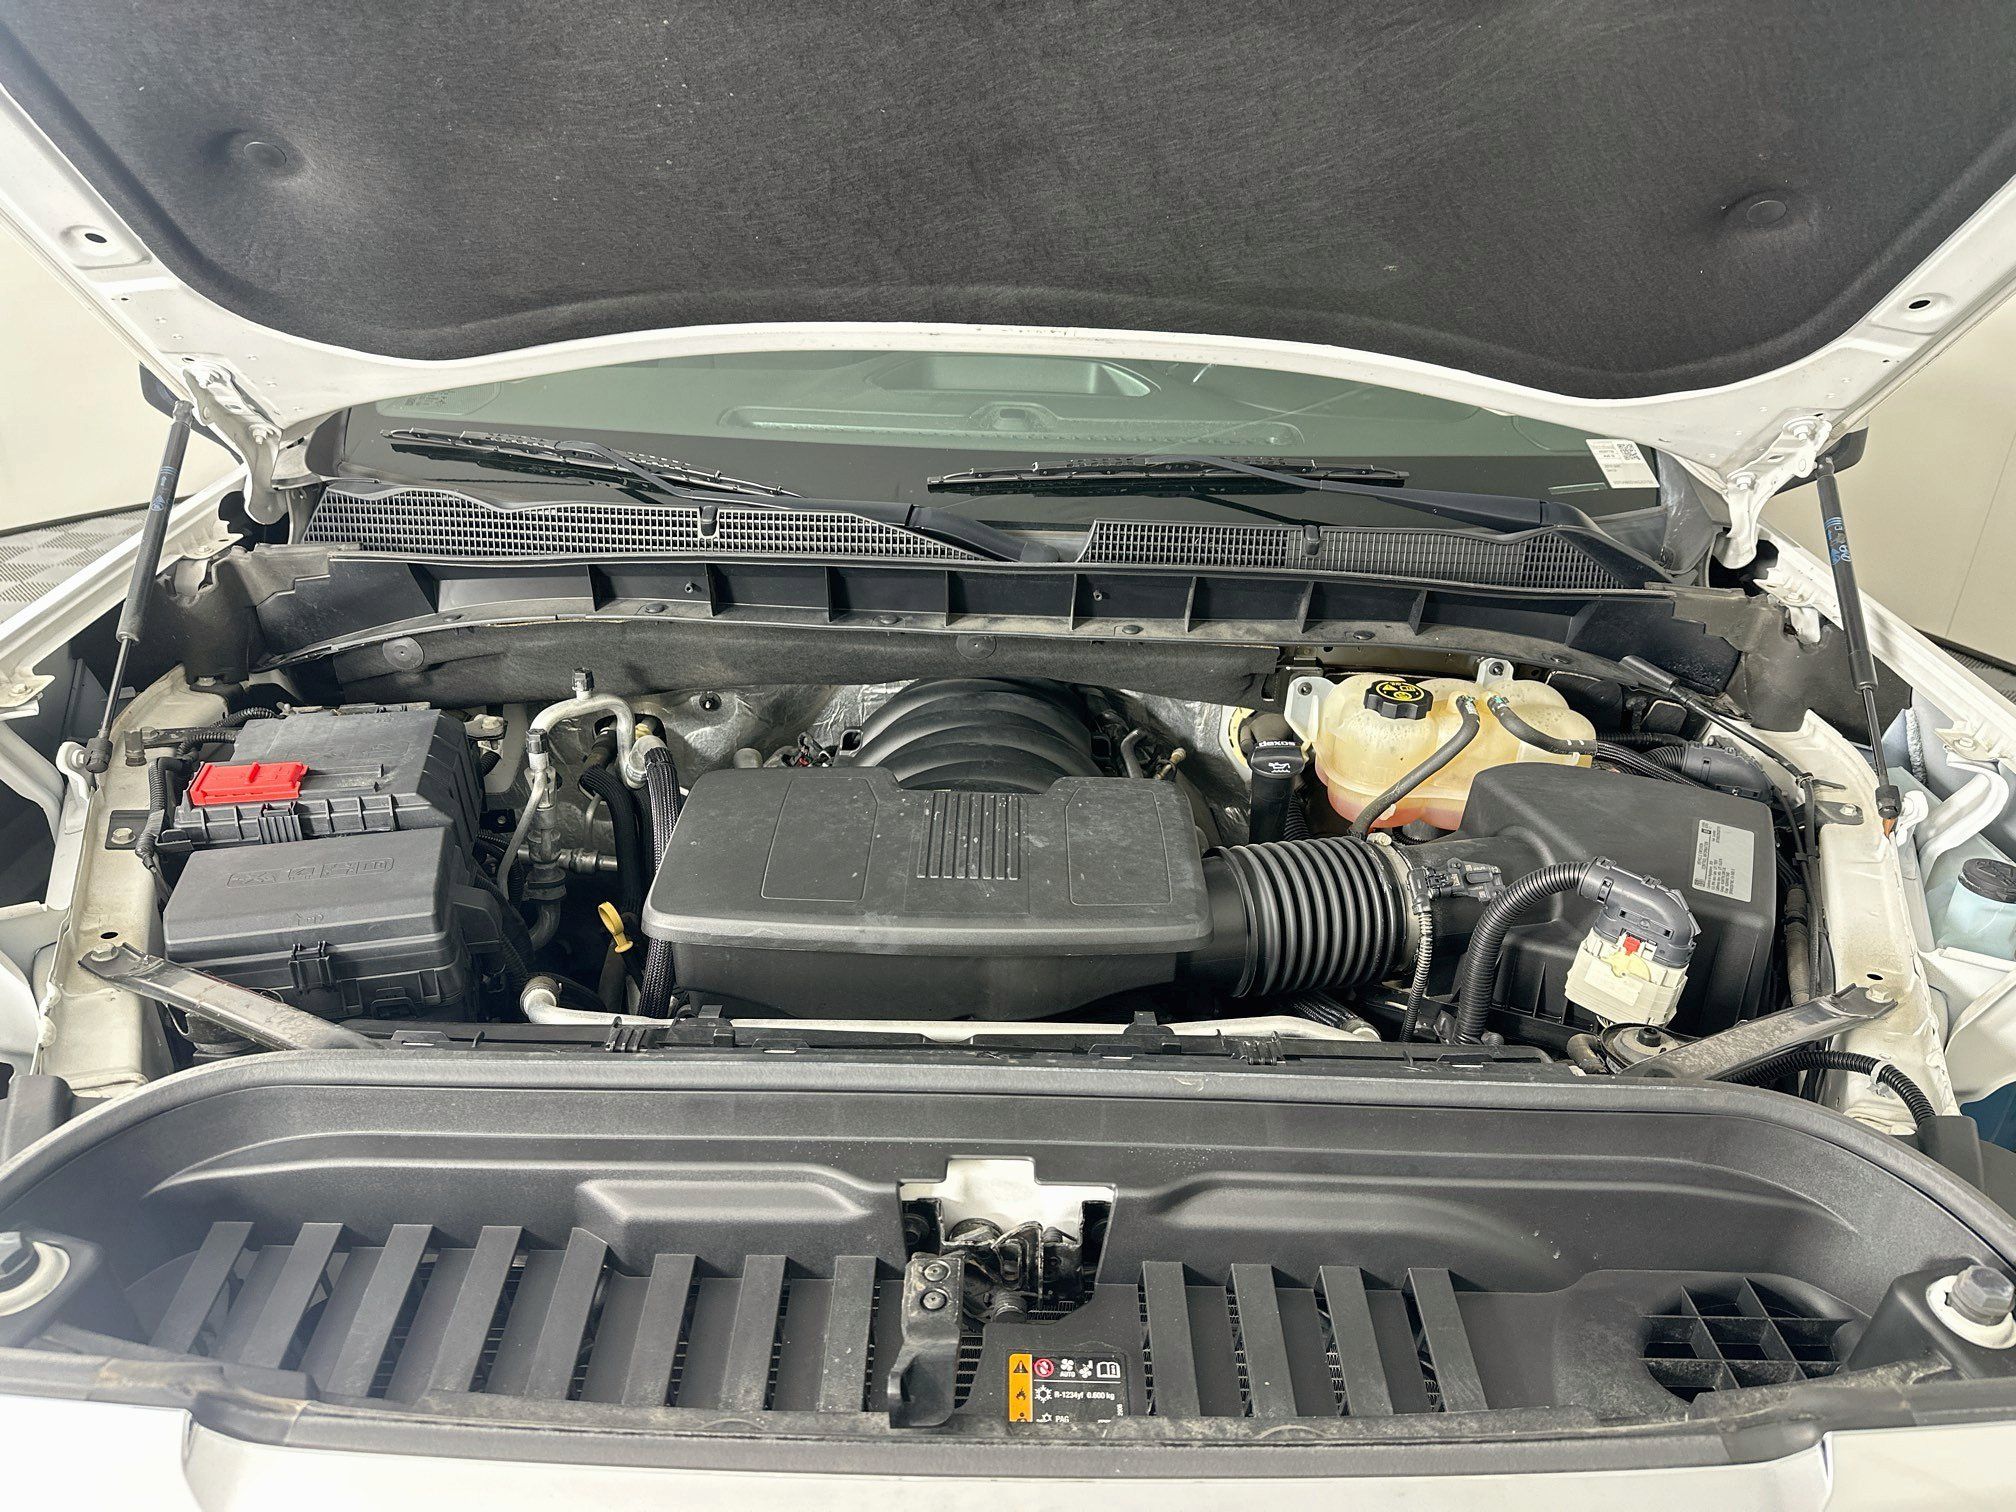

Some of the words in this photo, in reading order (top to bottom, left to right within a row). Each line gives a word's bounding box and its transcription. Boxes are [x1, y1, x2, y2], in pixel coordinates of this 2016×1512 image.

[1054, 1391, 1084, 1400] R-1234yf
[1106, 1391, 1115, 1401] kg
[1055, 1415, 1070, 1423] PAG
